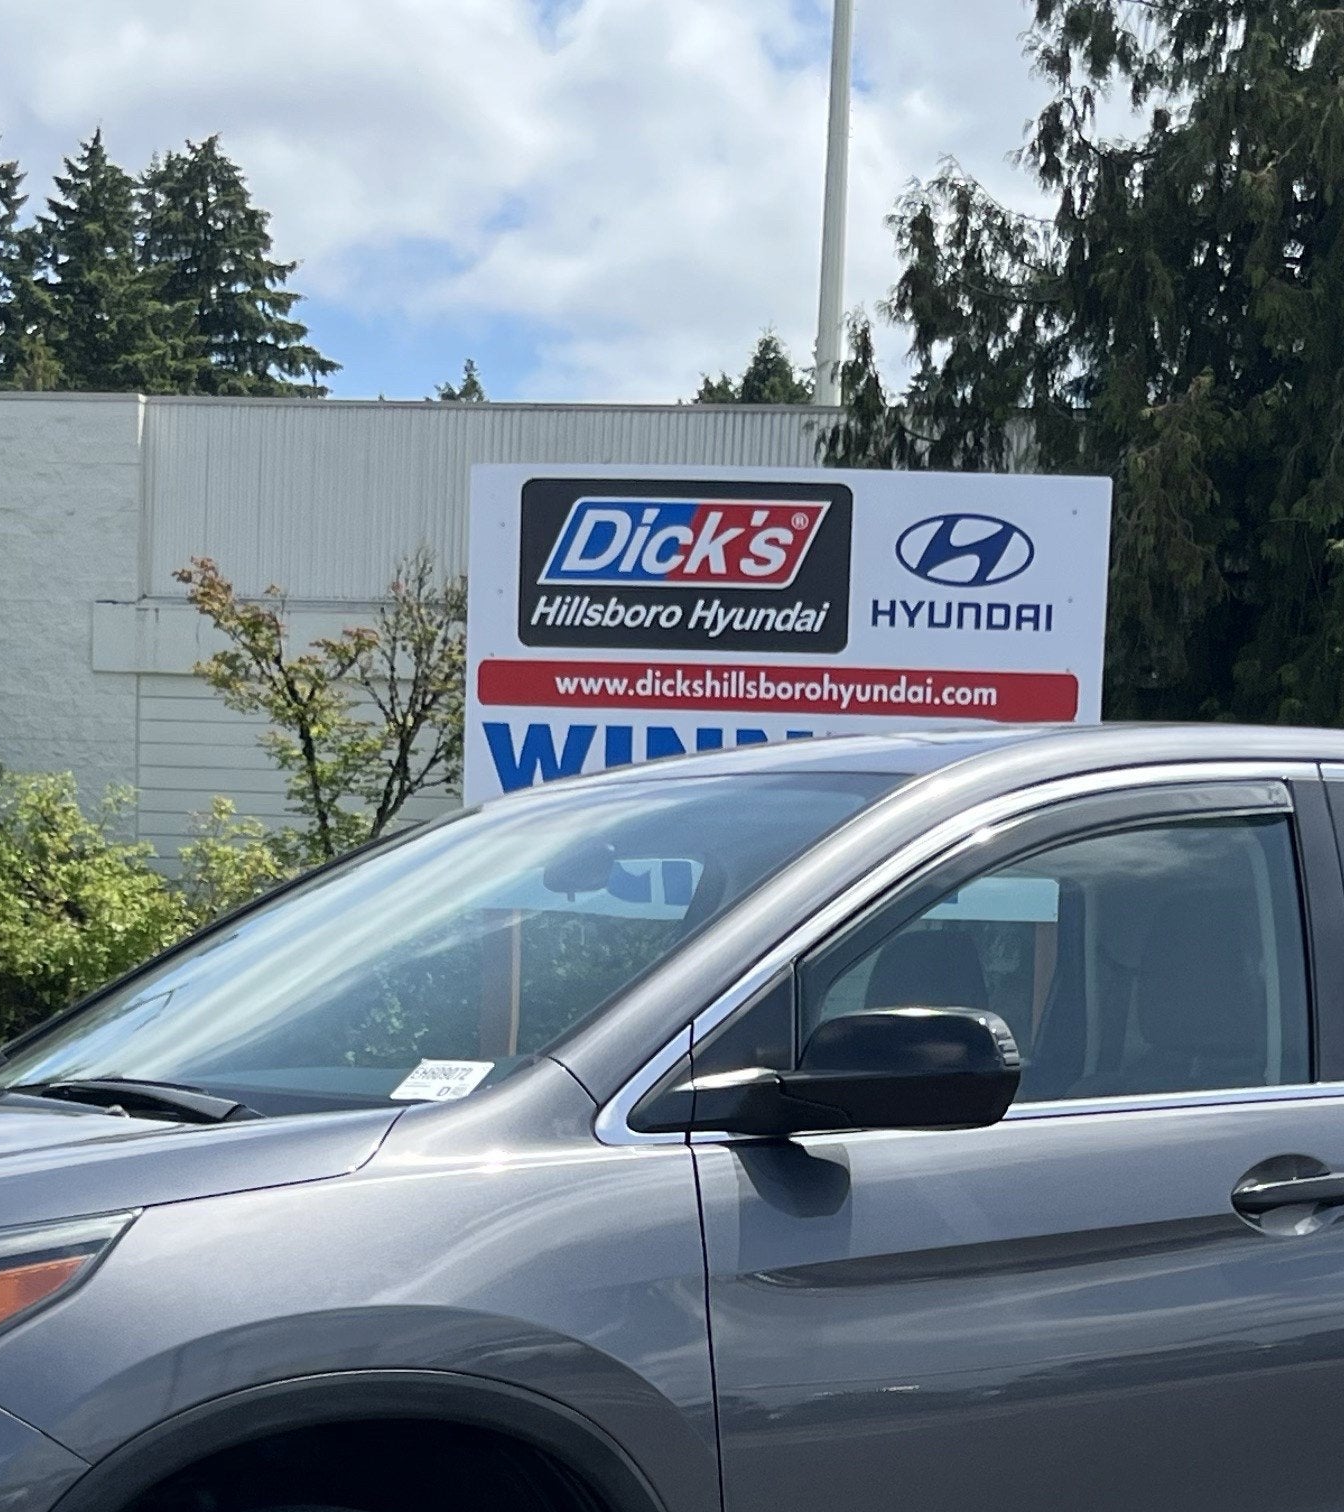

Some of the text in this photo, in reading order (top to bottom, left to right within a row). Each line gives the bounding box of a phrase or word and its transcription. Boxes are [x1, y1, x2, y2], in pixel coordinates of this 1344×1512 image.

[561, 508, 794, 577] Dick's
[530, 595, 830, 638] Hillsboro Hyundai
[871, 598, 1053, 632] HYUNDAI
[555, 668, 997, 709] www.dickshillsborohyundai.com
